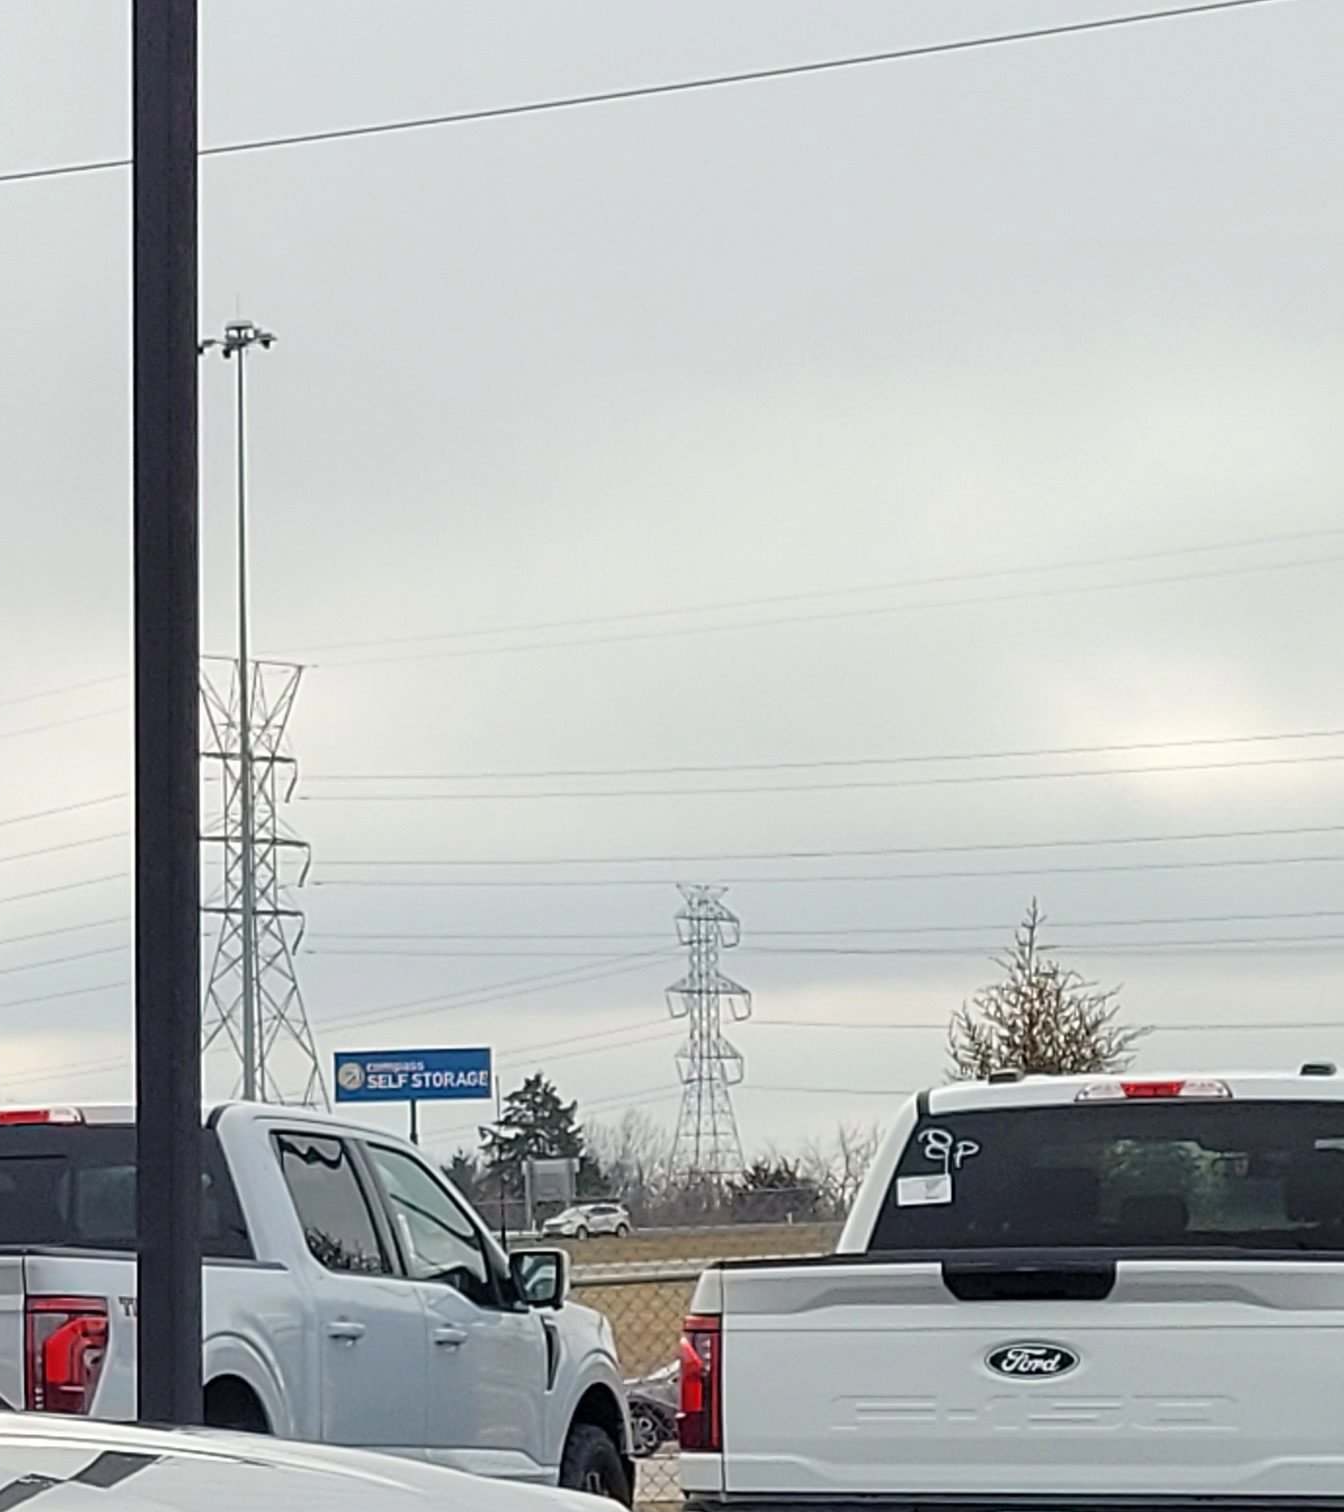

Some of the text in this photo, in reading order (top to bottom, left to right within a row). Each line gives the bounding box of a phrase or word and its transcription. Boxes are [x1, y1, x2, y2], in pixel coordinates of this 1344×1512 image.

[367, 1070, 489, 1089] SELF STORAGE
[1000, 1348, 1062, 1372] Ford
